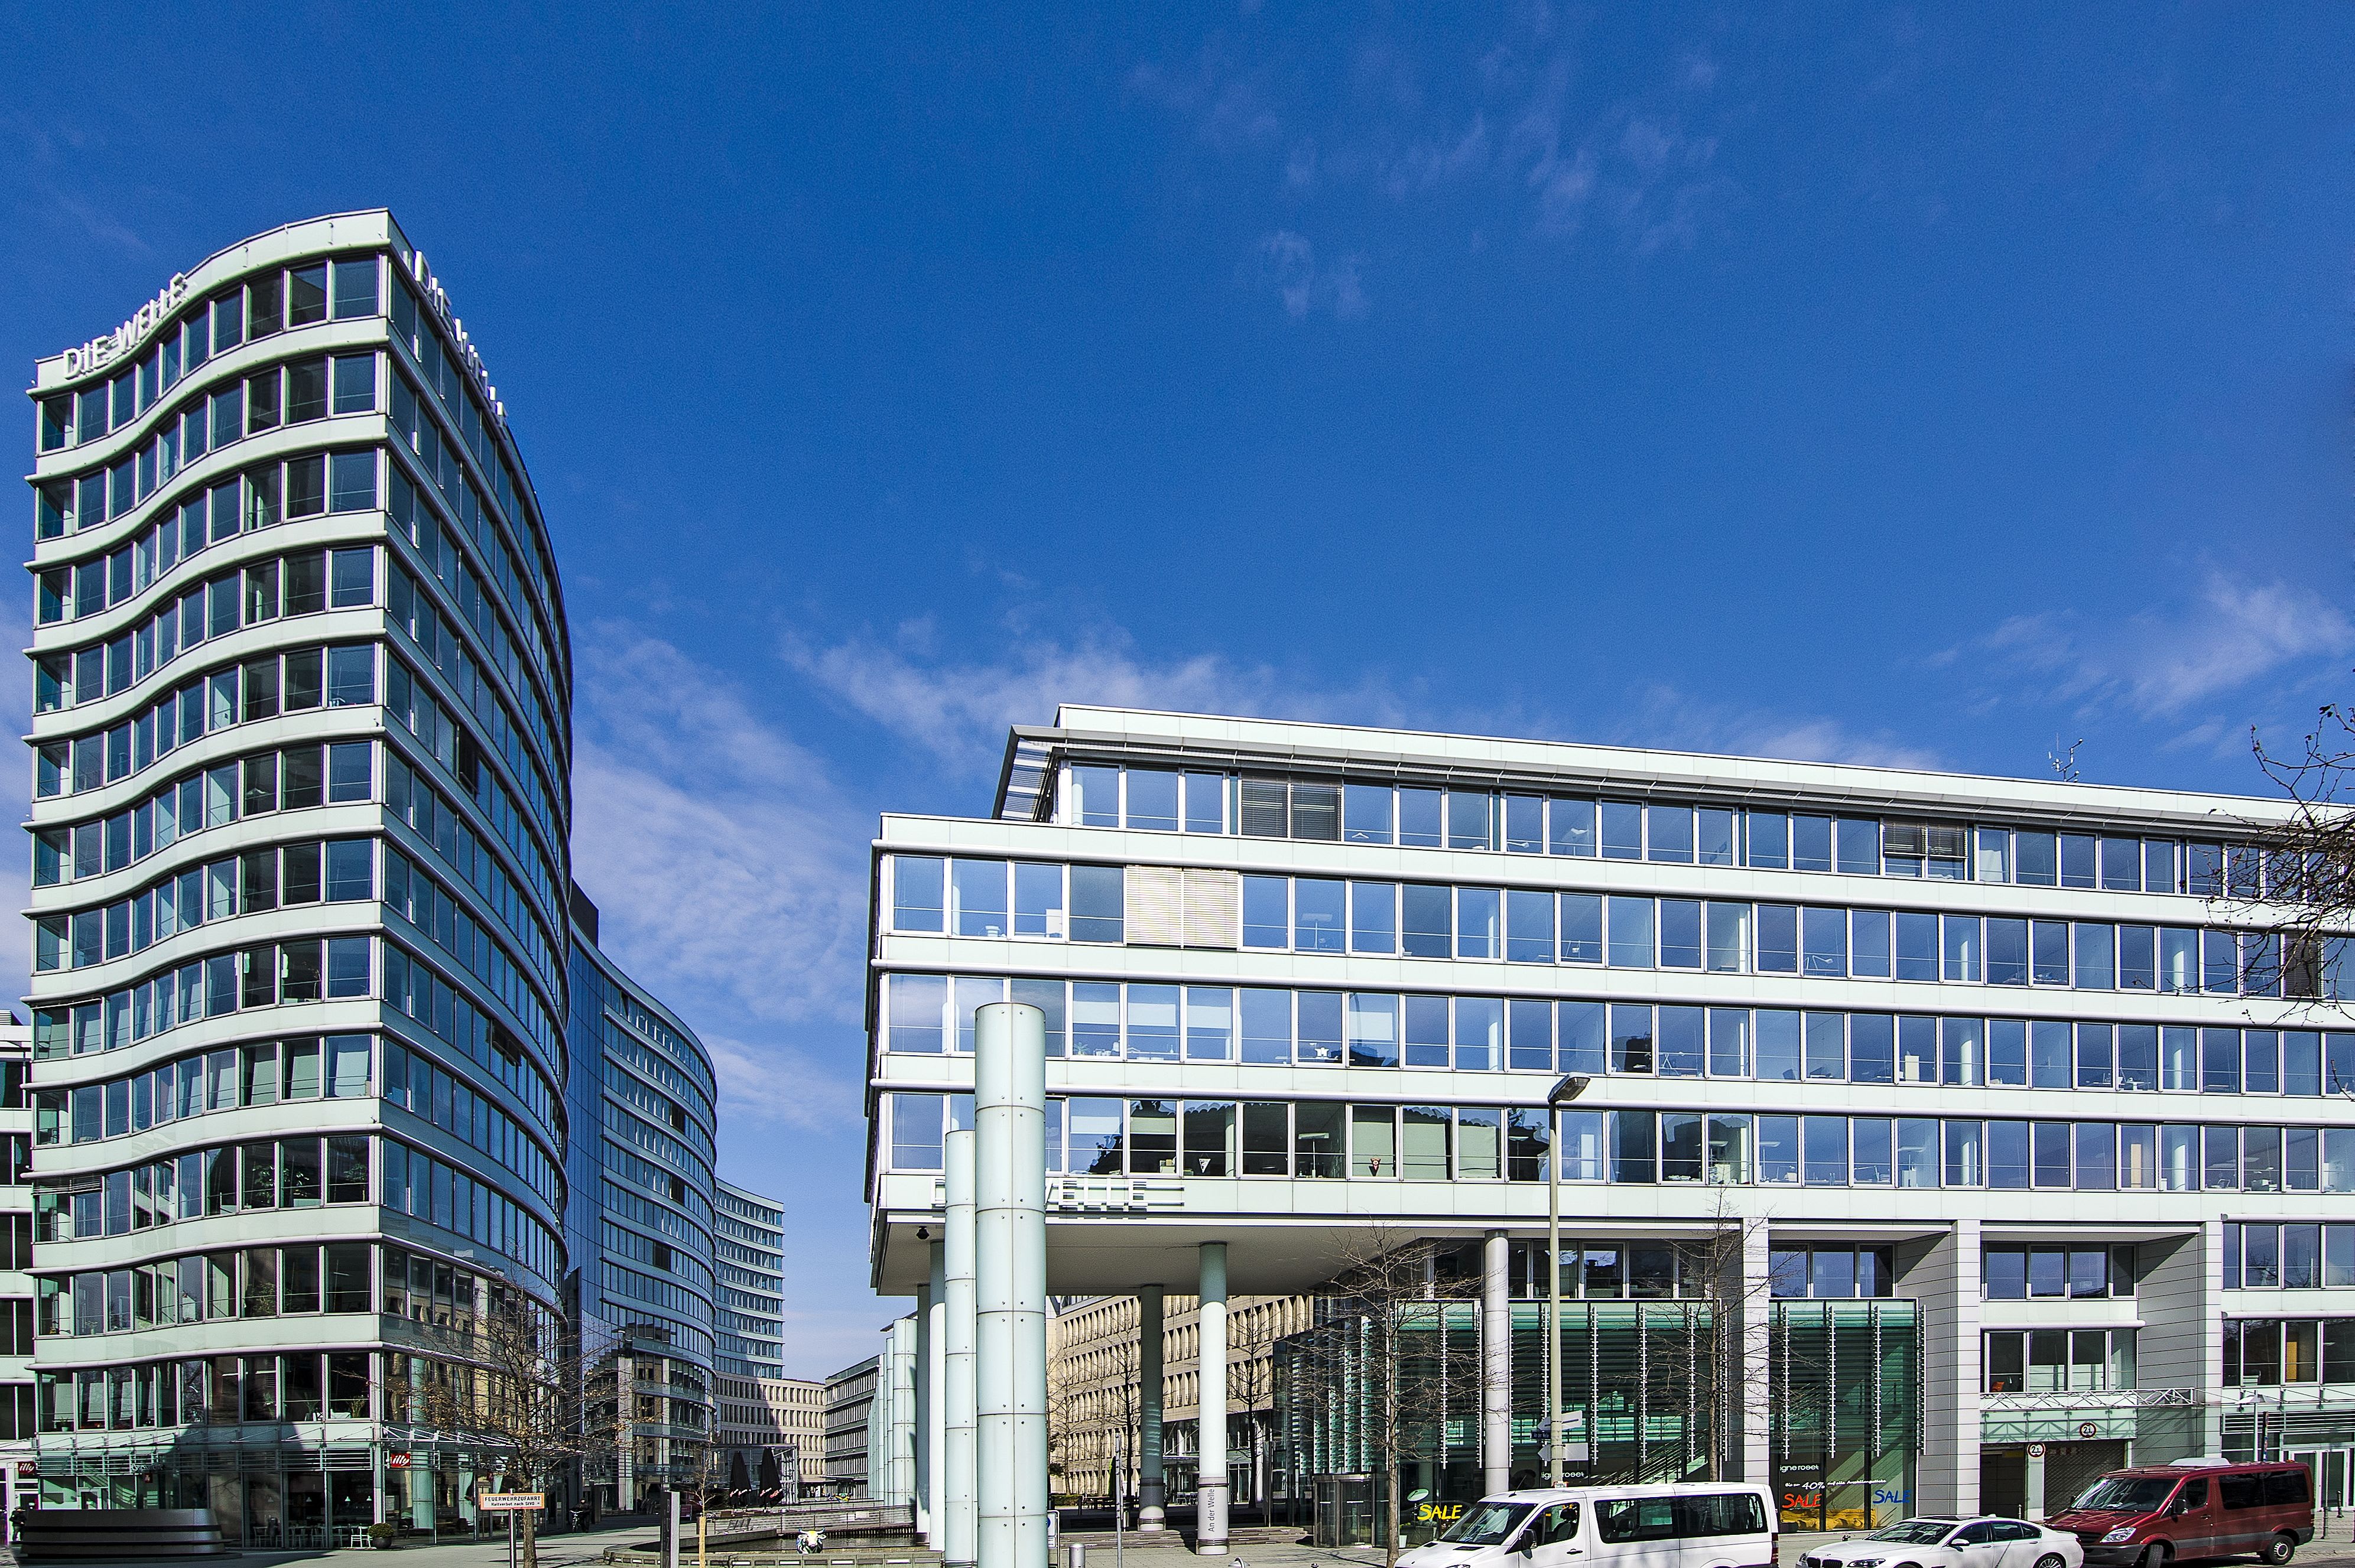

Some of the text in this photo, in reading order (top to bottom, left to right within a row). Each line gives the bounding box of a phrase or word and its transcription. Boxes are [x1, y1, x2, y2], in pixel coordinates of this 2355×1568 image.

[63, 272, 189, 380] DIE WELLE
[1045, 1177, 1148, 1206] ELLE
[19, 1463, 34, 1473] illy
[392, 1455, 410, 1466] illy
[1801, 1482, 1825, 1490] 40%
[1782, 1493, 1823, 1508] SALE
[1873, 1489, 1912, 1504] SALE
[1417, 1504, 1463, 1520] SALE
[1208, 1523, 1214, 1532] An
